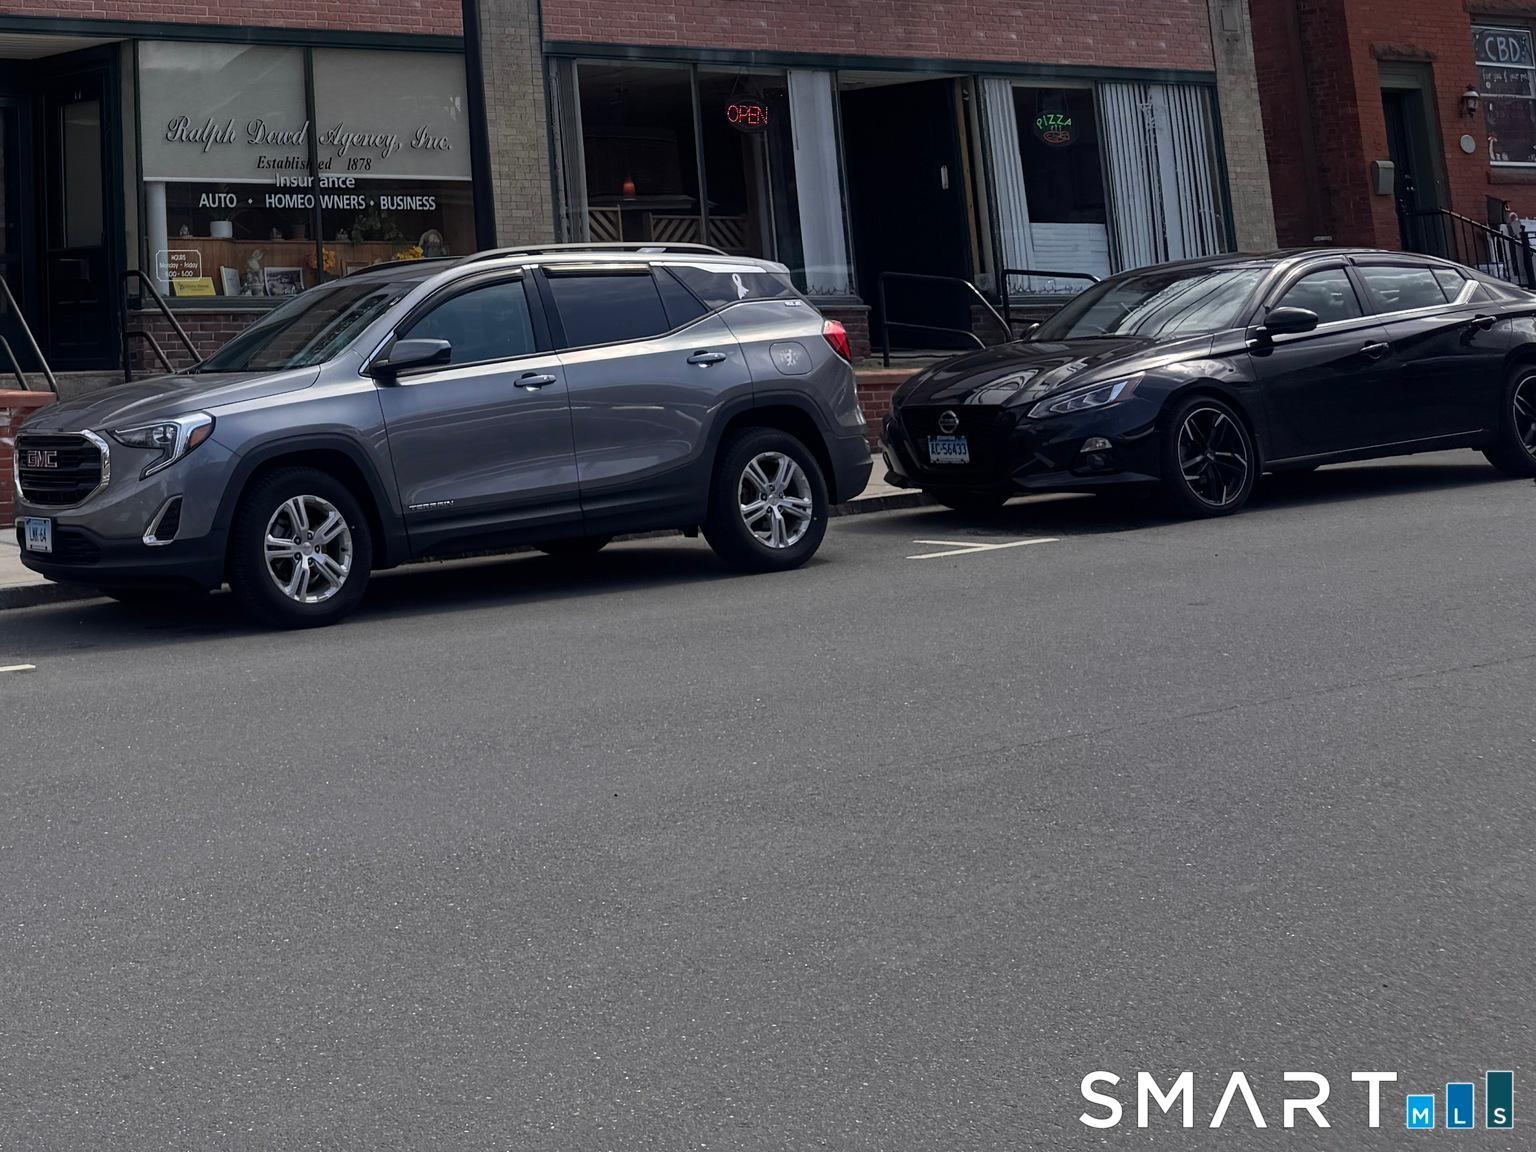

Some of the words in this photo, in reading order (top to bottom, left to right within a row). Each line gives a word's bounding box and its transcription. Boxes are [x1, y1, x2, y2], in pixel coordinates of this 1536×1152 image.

[1484, 36, 1520, 63] CBD
[726, 104, 768, 125] OPEN
[1036, 114, 1072, 130] PIZZA
[165, 115, 237, 152] Ralph
[246, 118, 310, 146] Dowd
[318, 122, 402, 159] Agency,
[409, 124, 452, 151] Inc.
[346, 156, 372, 172] 1878
[275, 173, 356, 189] Insurance
[199, 193, 237, 209] AUTO
[265, 193, 366, 210] HOMEOWNERS
[379, 195, 436, 211] BUSINESS
[27, 450, 58, 468] GMC
